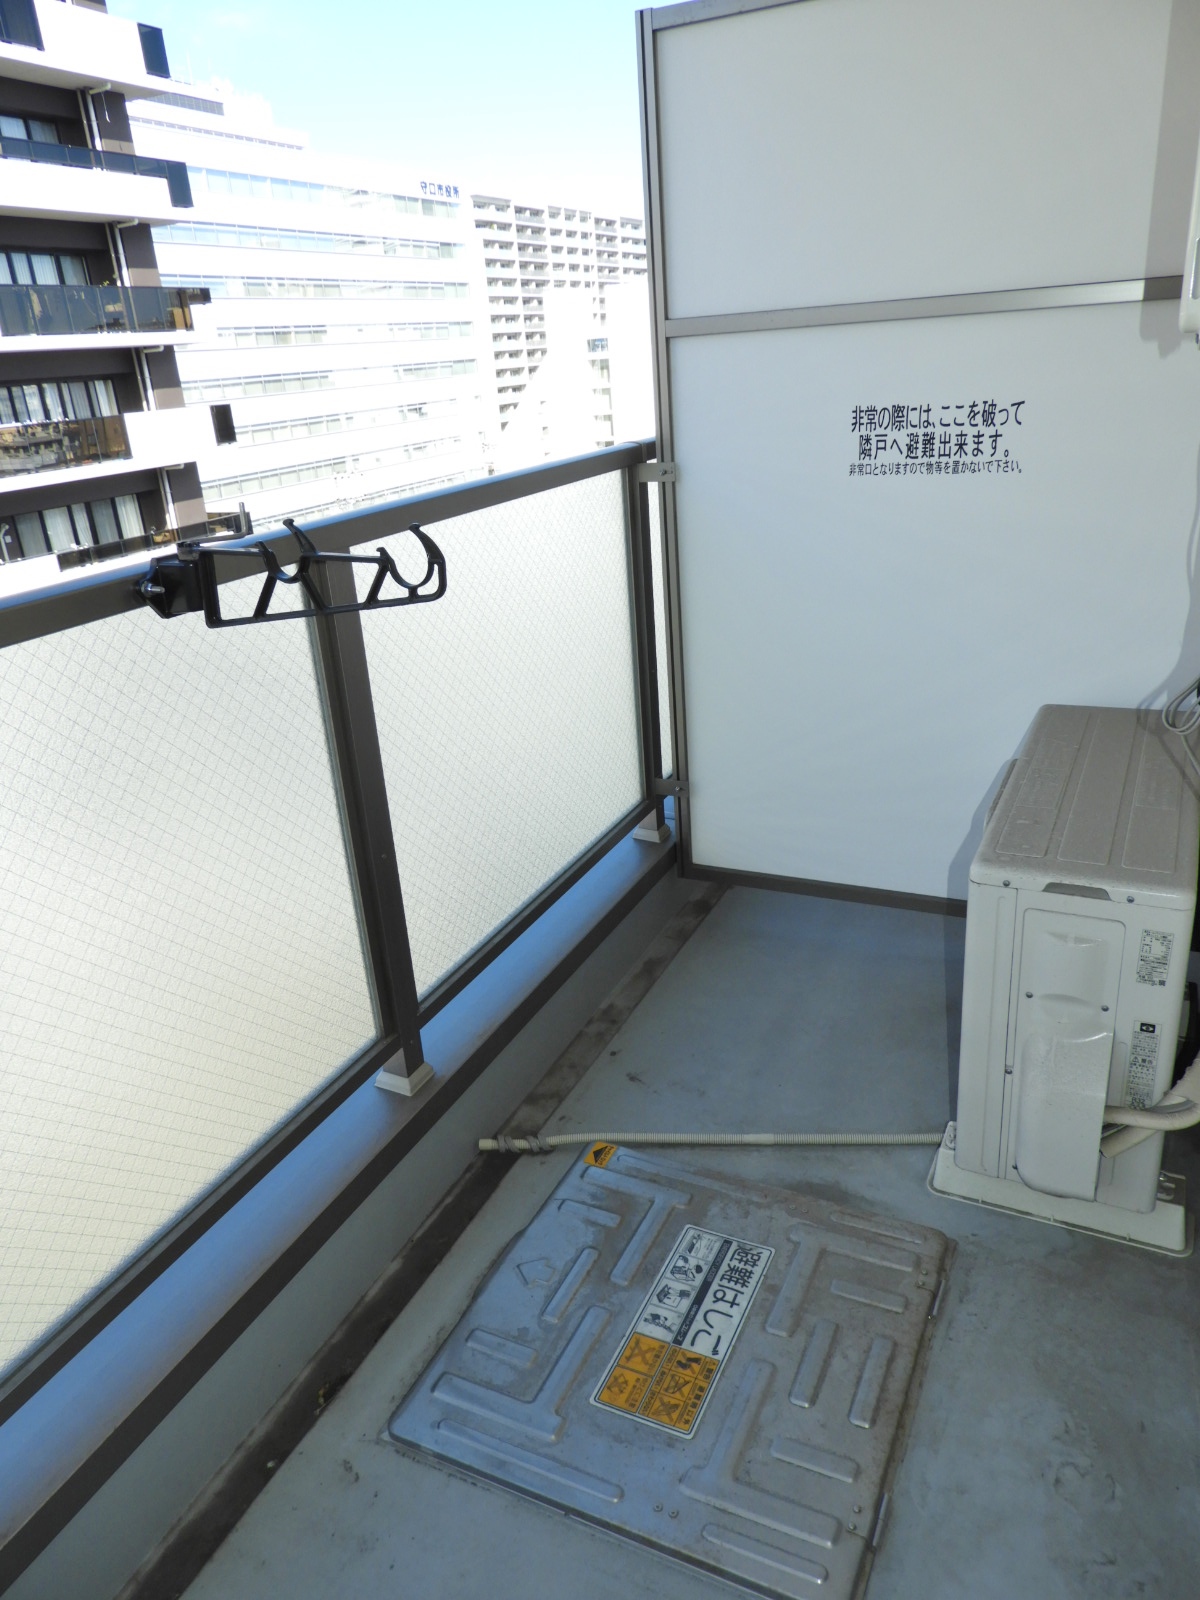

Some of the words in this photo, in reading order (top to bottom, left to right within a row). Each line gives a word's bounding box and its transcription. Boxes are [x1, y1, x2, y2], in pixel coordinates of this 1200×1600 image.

[851, 399, 1025, 432] 非常の際には、ここを破って
[858, 429, 1009, 460] 隣戸へ避難出来ます。
[849, 459, 1022, 476] 非常口となりますので物等を置かないで下さい。
[691, 1244, 762, 1356] 避難はしご
